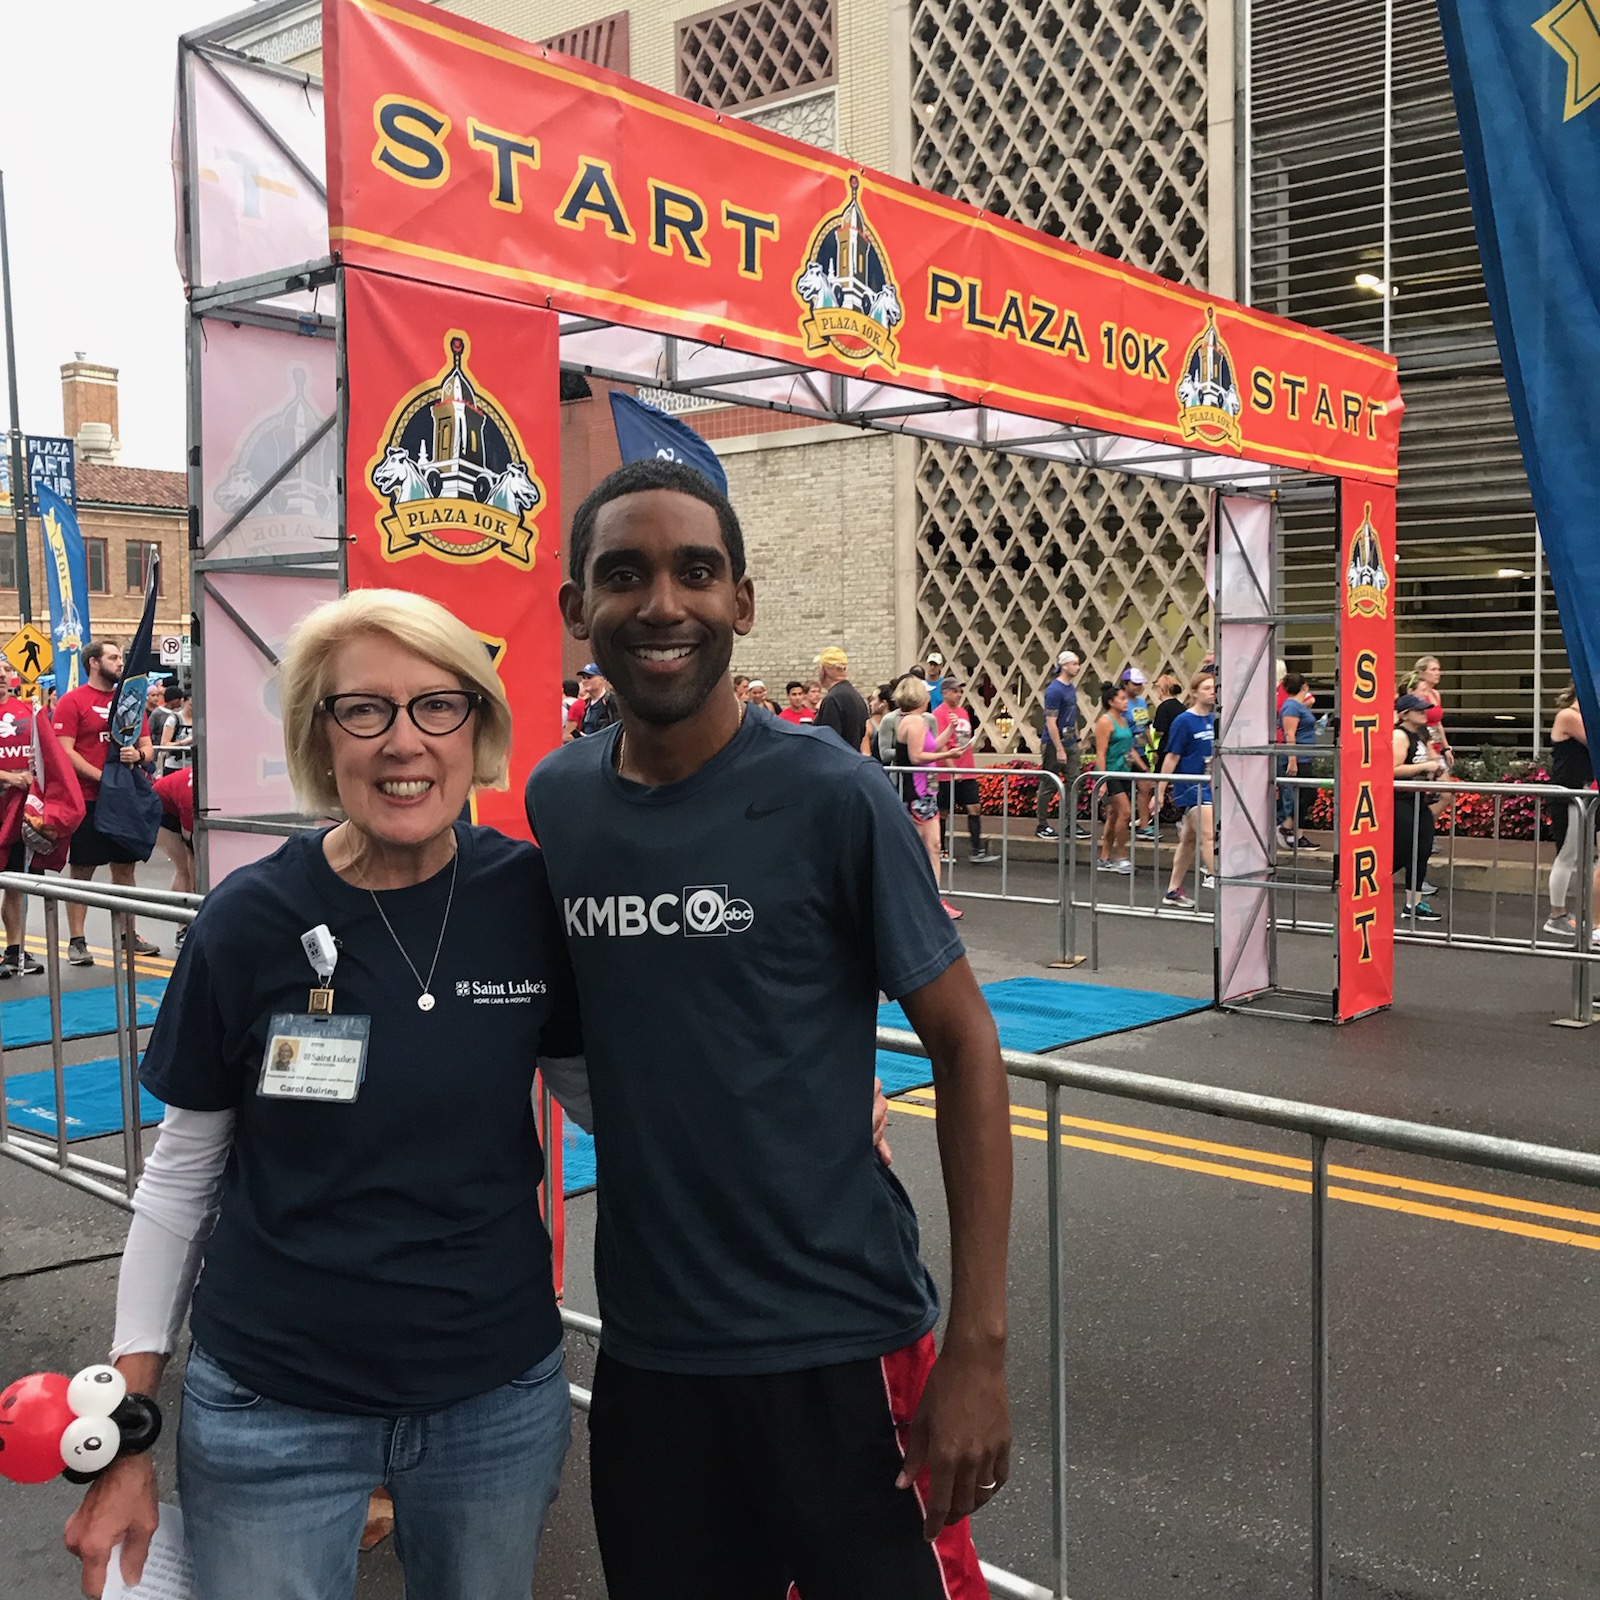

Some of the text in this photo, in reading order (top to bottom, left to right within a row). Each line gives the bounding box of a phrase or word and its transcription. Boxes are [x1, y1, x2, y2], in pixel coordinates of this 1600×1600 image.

[374, 95, 778, 278] START
[821, 317, 881, 346] PLAZA 10K
[928, 269, 1168, 381] PLAZA 10K
[1189, 411, 1215, 423] PLAZA
[1252, 369, 1386, 440] START
[29, 440, 70, 455] PLAZA
[31, 454, 70, 476] ART
[407, 508, 508, 536] PLAZA 10K
[1350, 650, 1378, 962] START
[563, 889, 752, 937] KMBC 9 abc
[472, 979, 547, 996] Saint Luke's
[311, 1053, 331, 1061] Saint
[280, 1084, 338, 1096] Carol Quiring
